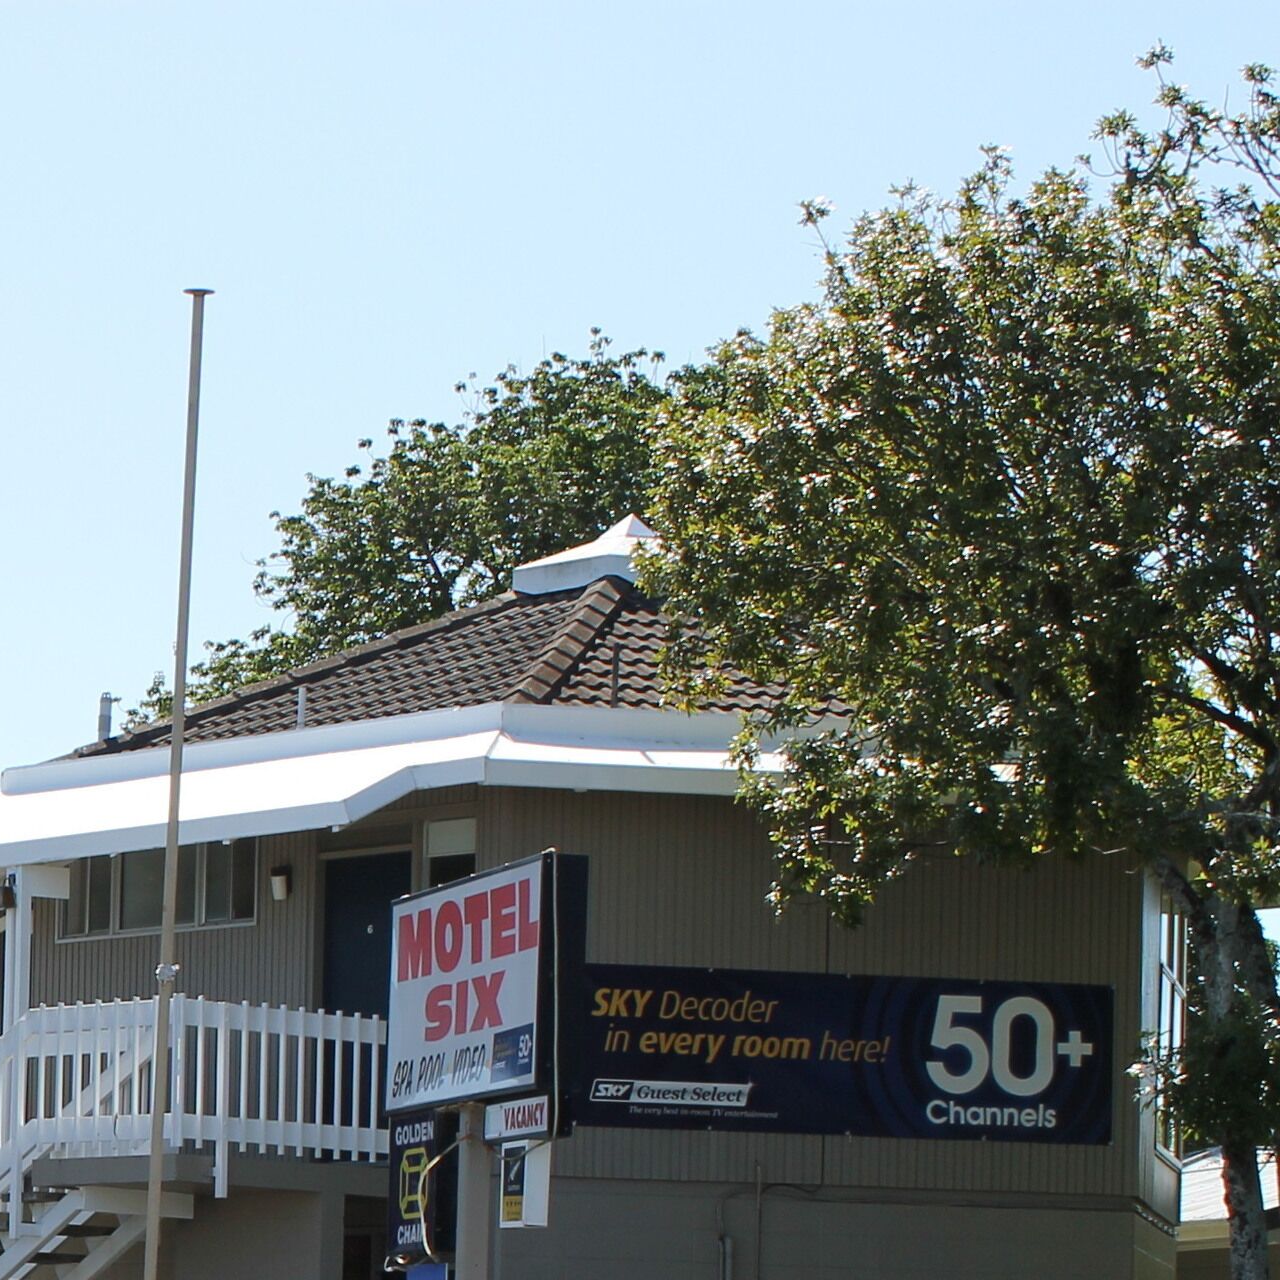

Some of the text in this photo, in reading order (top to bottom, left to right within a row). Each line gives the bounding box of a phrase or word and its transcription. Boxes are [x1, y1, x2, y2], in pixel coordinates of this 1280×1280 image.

[367, 924, 374, 934] 6
[397, 878, 539, 983] MOTEL
[424, 969, 506, 1042] SIX
[591, 988, 779, 1023] SKY Decoder
[604, 1022, 891, 1063] in every room here!
[926, 994, 1093, 1096] 50+
[392, 1059, 414, 1098] SPA
[416, 1051, 446, 1093] POOL
[451, 1043, 486, 1086] VIDEO
[594, 1083, 743, 1103] SKY Guest Select
[504, 1102, 545, 1131] VACANCY
[926, 1100, 1057, 1128] Channels
[395, 1121, 434, 1146] GOLDEN
